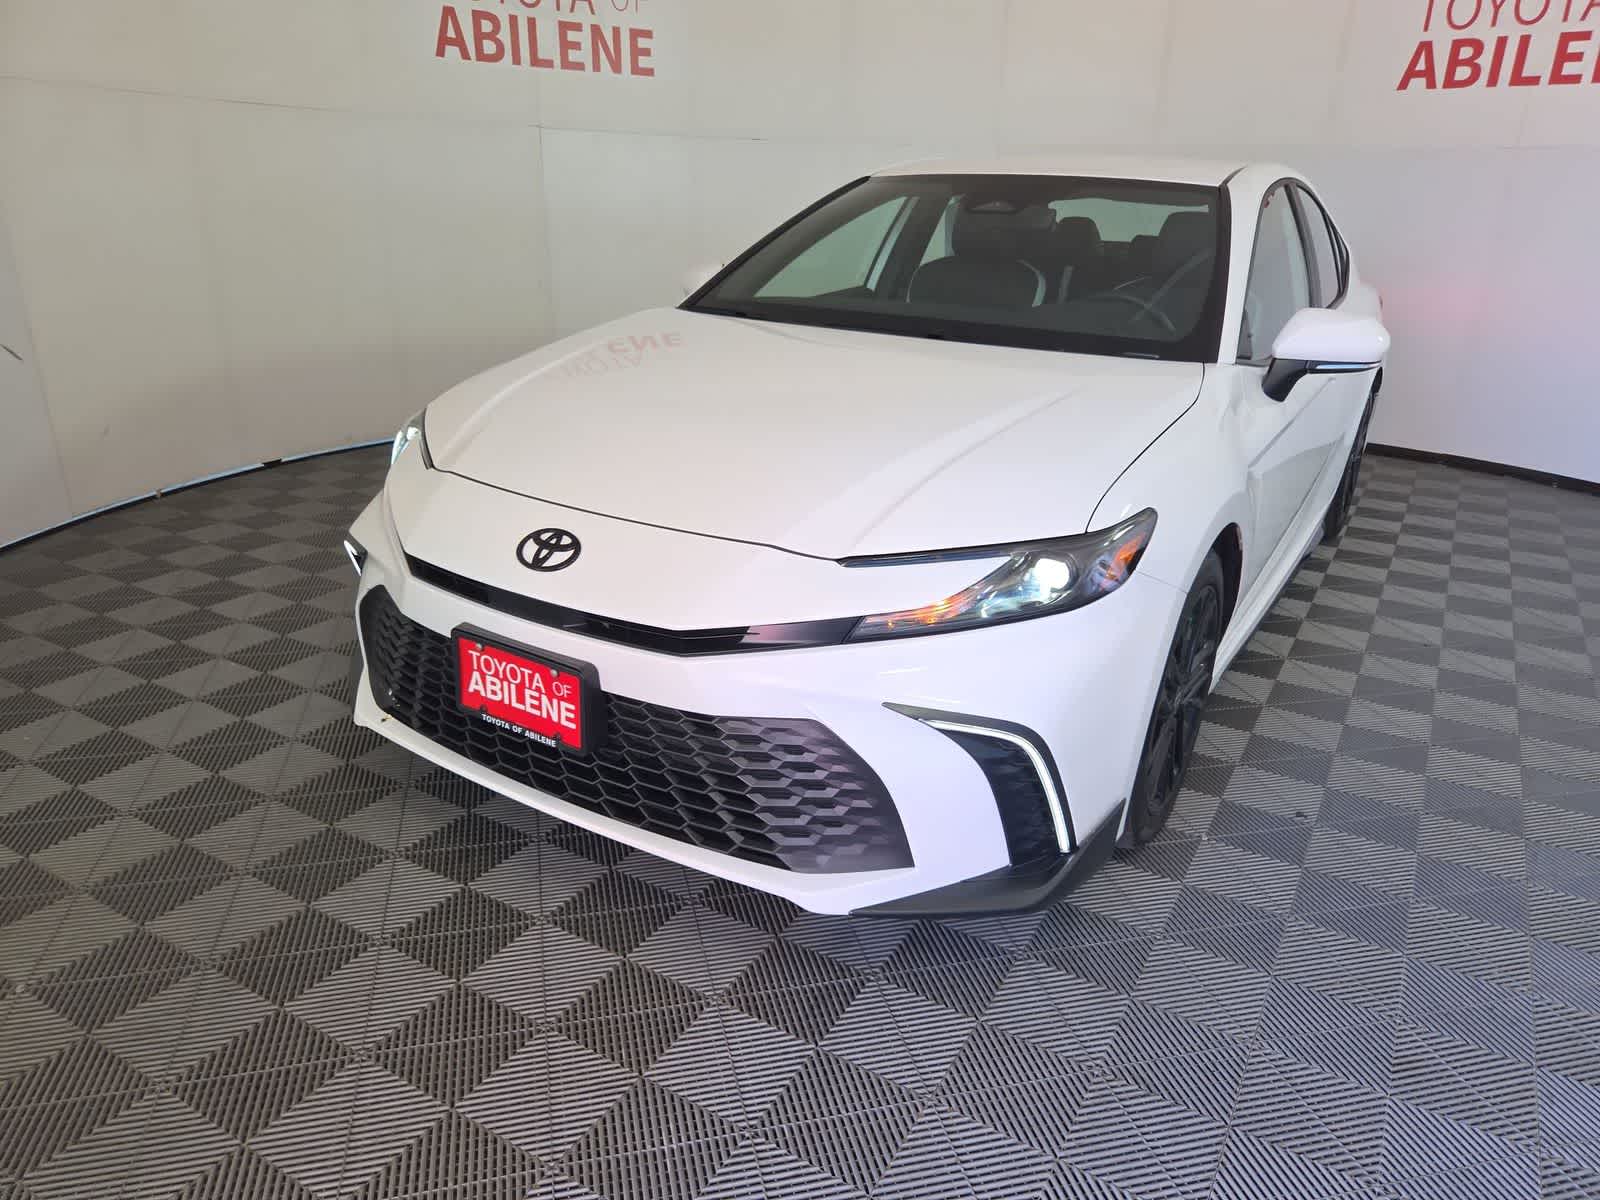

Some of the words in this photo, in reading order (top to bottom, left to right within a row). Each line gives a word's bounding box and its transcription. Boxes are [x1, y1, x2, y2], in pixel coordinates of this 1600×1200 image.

[435, 5, 655, 77] ABILENE
[1396, 30, 1600, 91] ABILE
[468, 650, 545, 693] TOYOTA
[552, 681, 572, 697] OF
[468, 671, 577, 729] ABILENE
[481, 713, 510, 730] TOYOTA
[512, 723, 523, 733] OF
[524, 730, 557, 748] ABILENE
